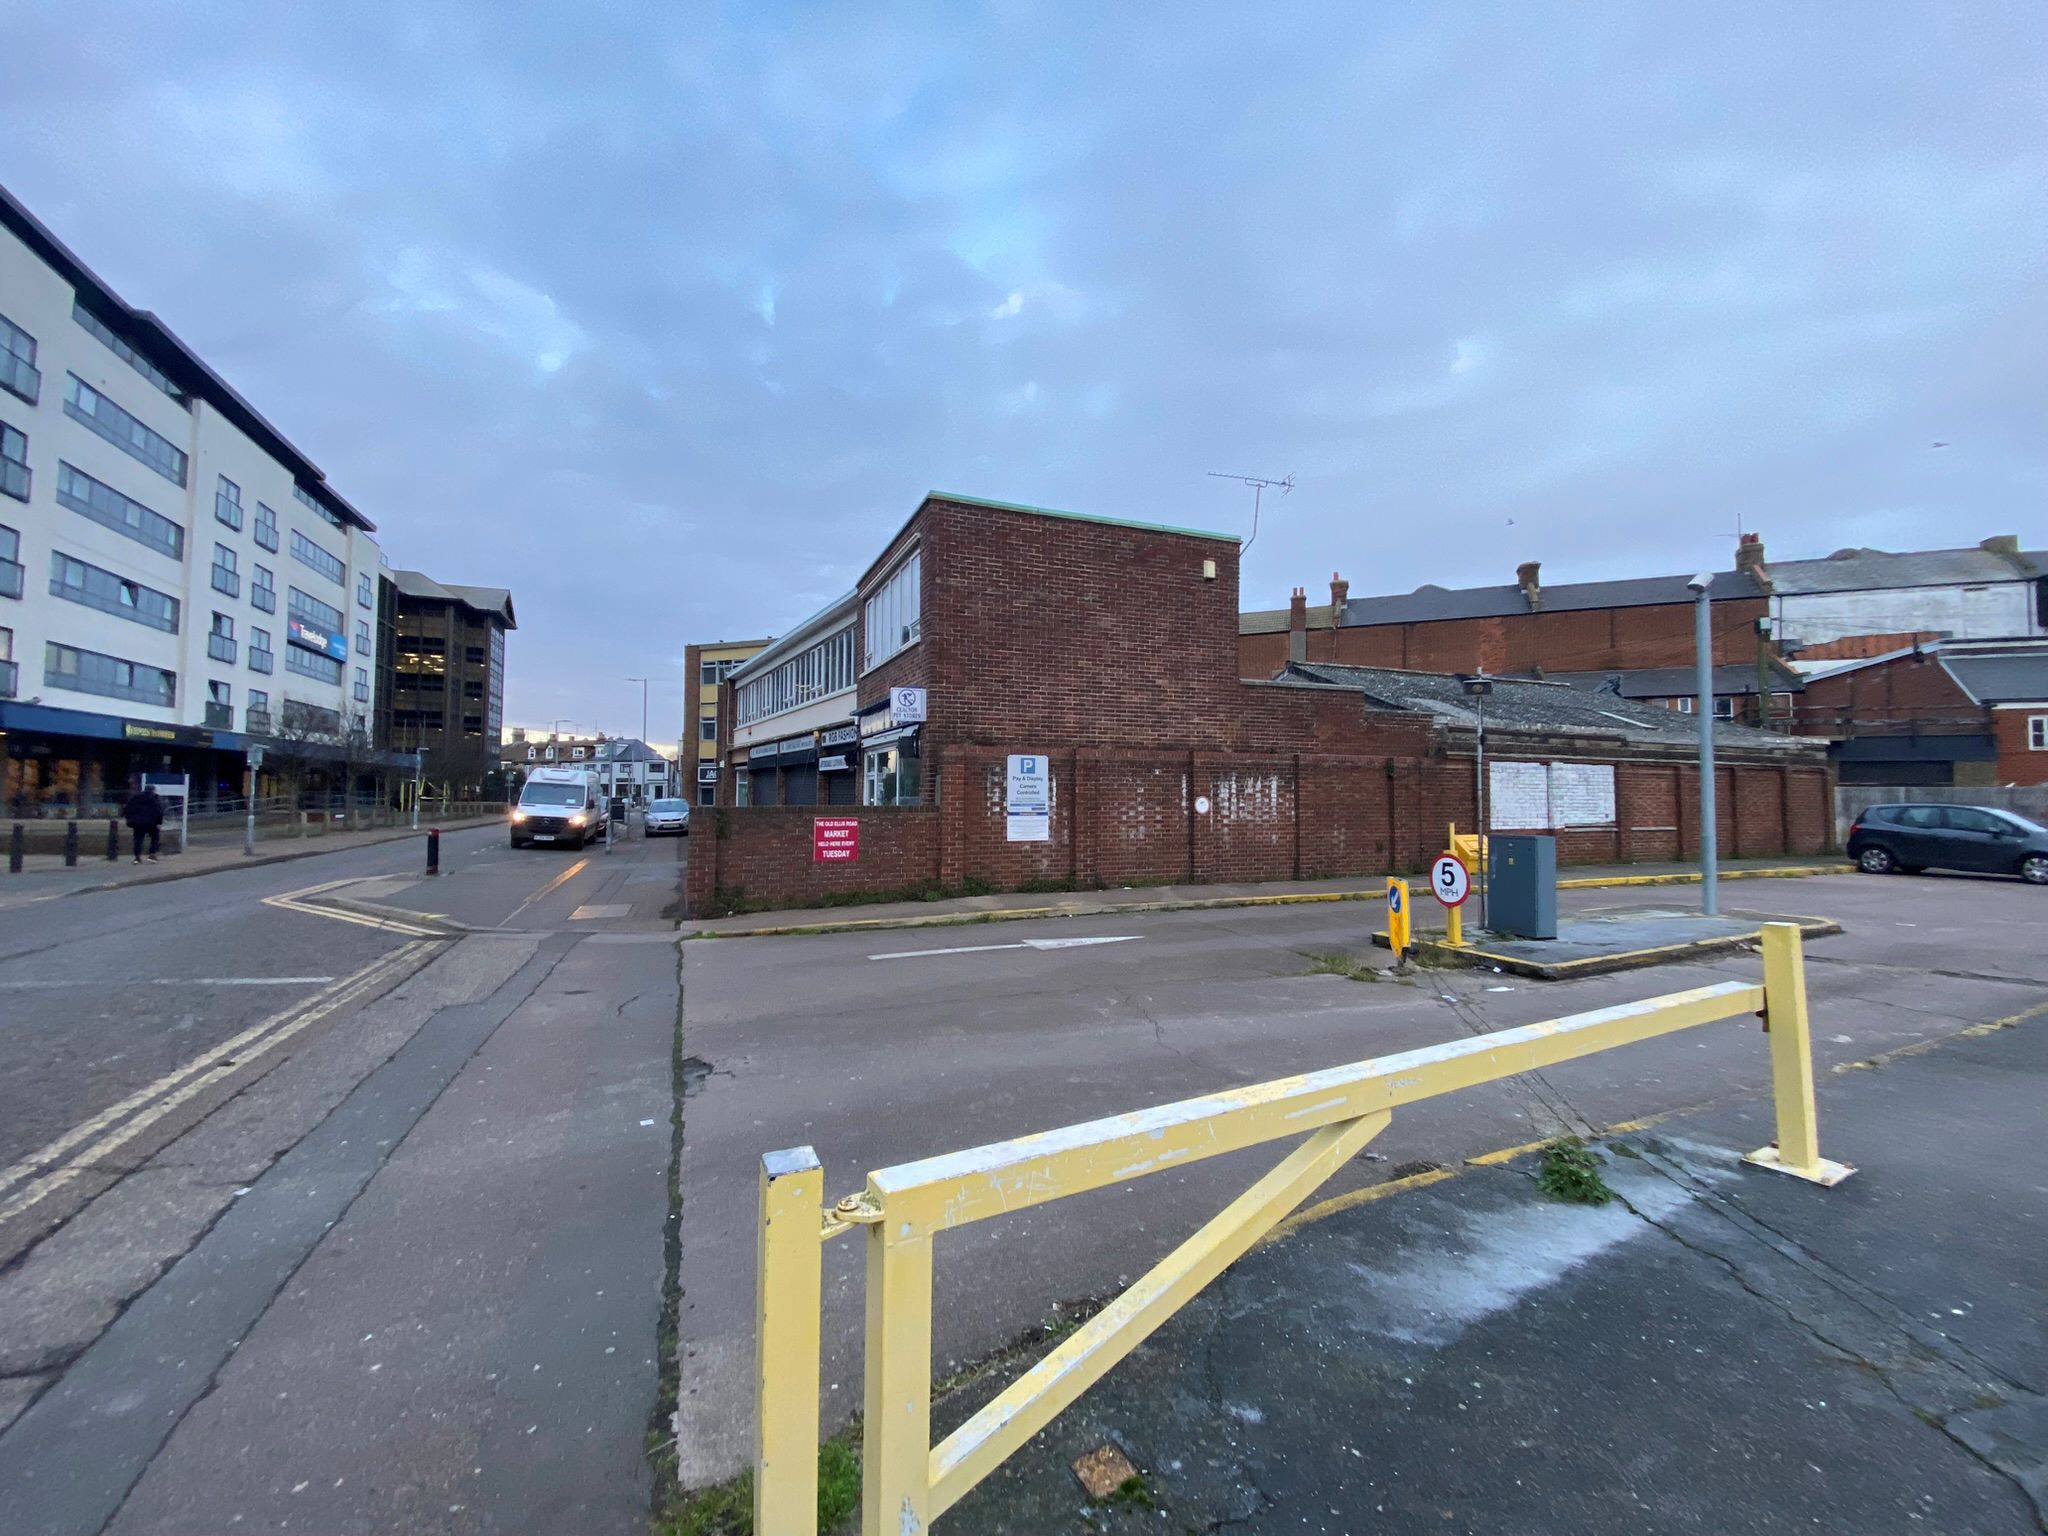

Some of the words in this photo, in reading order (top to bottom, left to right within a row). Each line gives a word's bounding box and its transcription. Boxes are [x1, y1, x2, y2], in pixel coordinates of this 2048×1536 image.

[300, 624, 328, 649] Travelodge
[1024, 760, 1033, 772] P
[824, 830, 849, 838] MARKET
[822, 850, 850, 858] TUESDAY
[1441, 862, 1455, 887] 5
[1440, 887, 1459, 897] MPH
